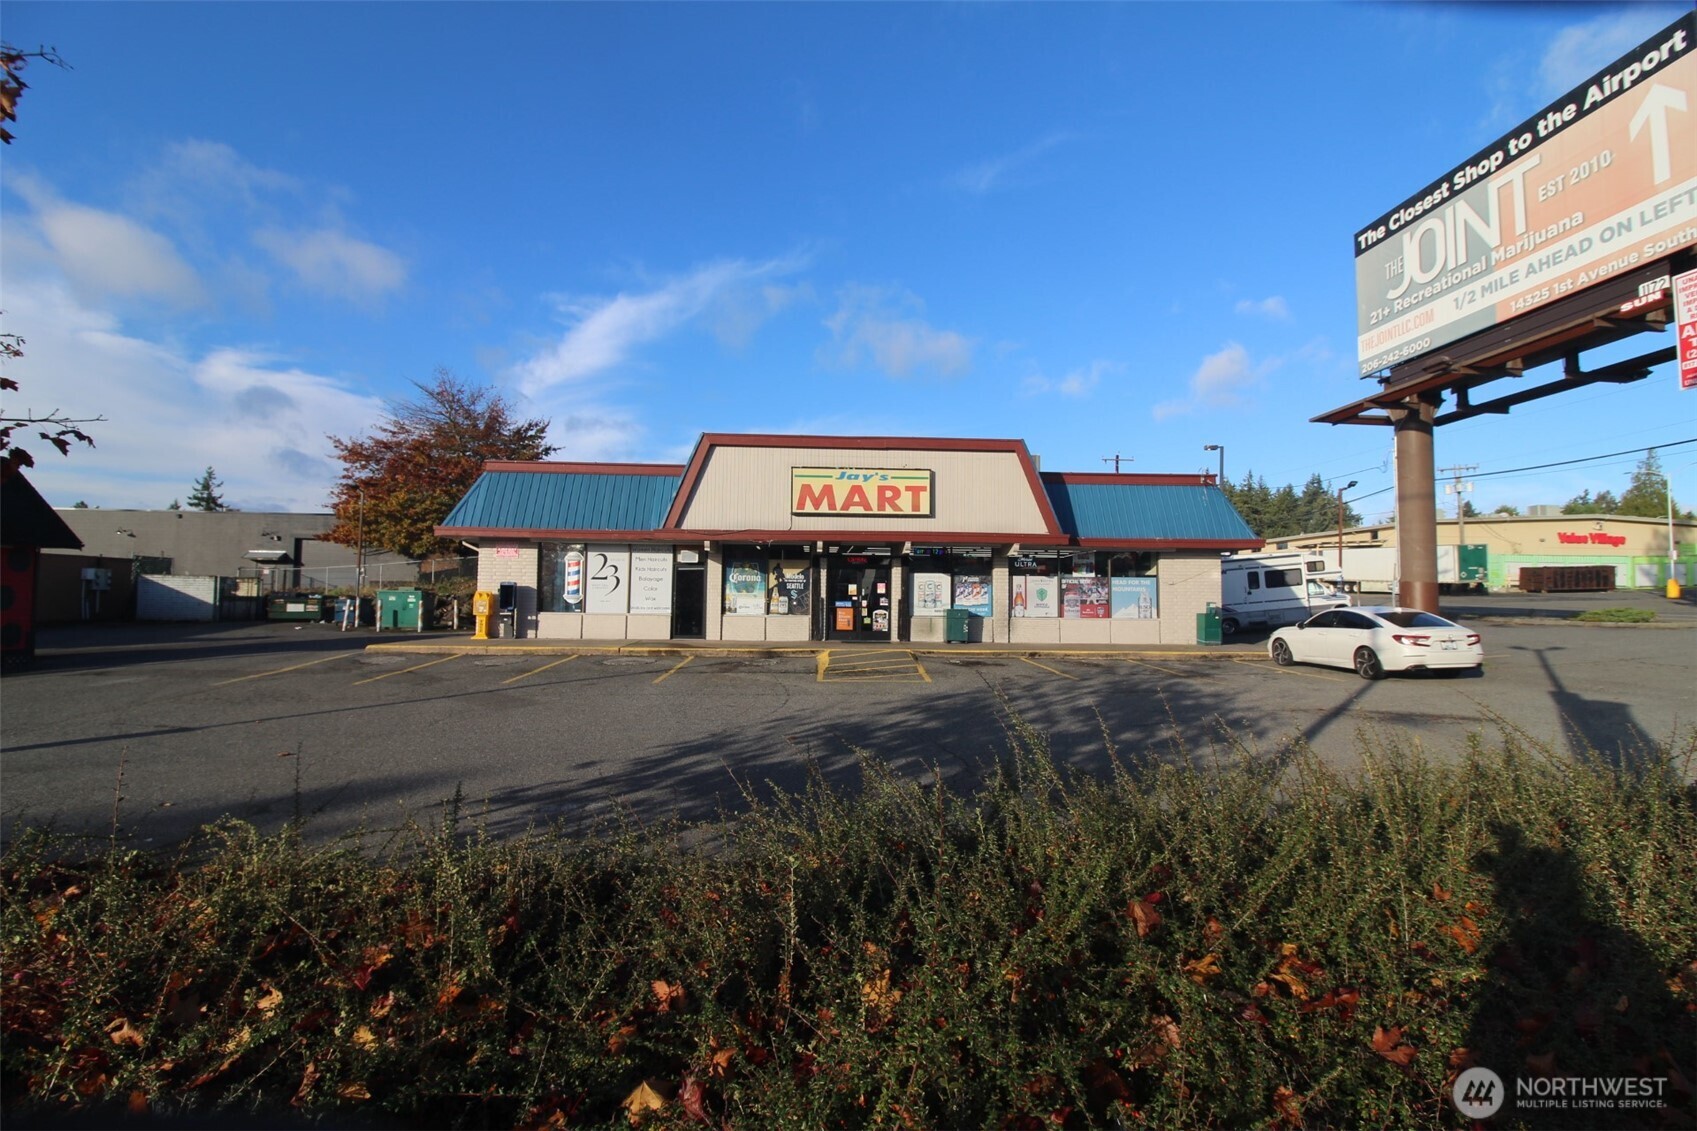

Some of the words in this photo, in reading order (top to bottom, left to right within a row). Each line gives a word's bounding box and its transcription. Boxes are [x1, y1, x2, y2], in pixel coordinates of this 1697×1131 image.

[1358, 225, 1386, 249] The
[1389, 181, 1450, 230] Closest
[1453, 150, 1504, 190] Shop
[1508, 131, 1533, 156] to
[1537, 102, 1577, 138] the
[1583, 28, 1688, 111] Airport
[1538, 175, 1565, 202] EST
[1570, 149, 1612, 185] 2010
[1386, 153, 1541, 300] JOINT
[1453, 289, 1477, 310] 1/2
[1481, 269, 1520, 298] MILE
[1525, 237, 1594, 279] AHEAD
[1599, 217, 1633, 243] ON
[1640, 185, 1697, 227] LEFT
[1553, 278, 1574, 294] 1st
[1577, 252, 1639, 286] Avenue
[1644, 226, 1697, 257] South
[1370, 306, 1391, 325] 21+
[1394, 255, 1488, 314] Recreational
[1491, 211, 1584, 266] Marijuana
[1385, 256, 1404, 280] THE
[1620, 289, 1664, 312] SUN
[1362, 337, 1431, 374] 206-242-6000
[835, 471, 889, 482] Jay's
[796, 483, 927, 512] MART
[1557, 532, 1588, 544] Value
[1589, 533, 1626, 547] Village
[729, 573, 761, 583] Corona
